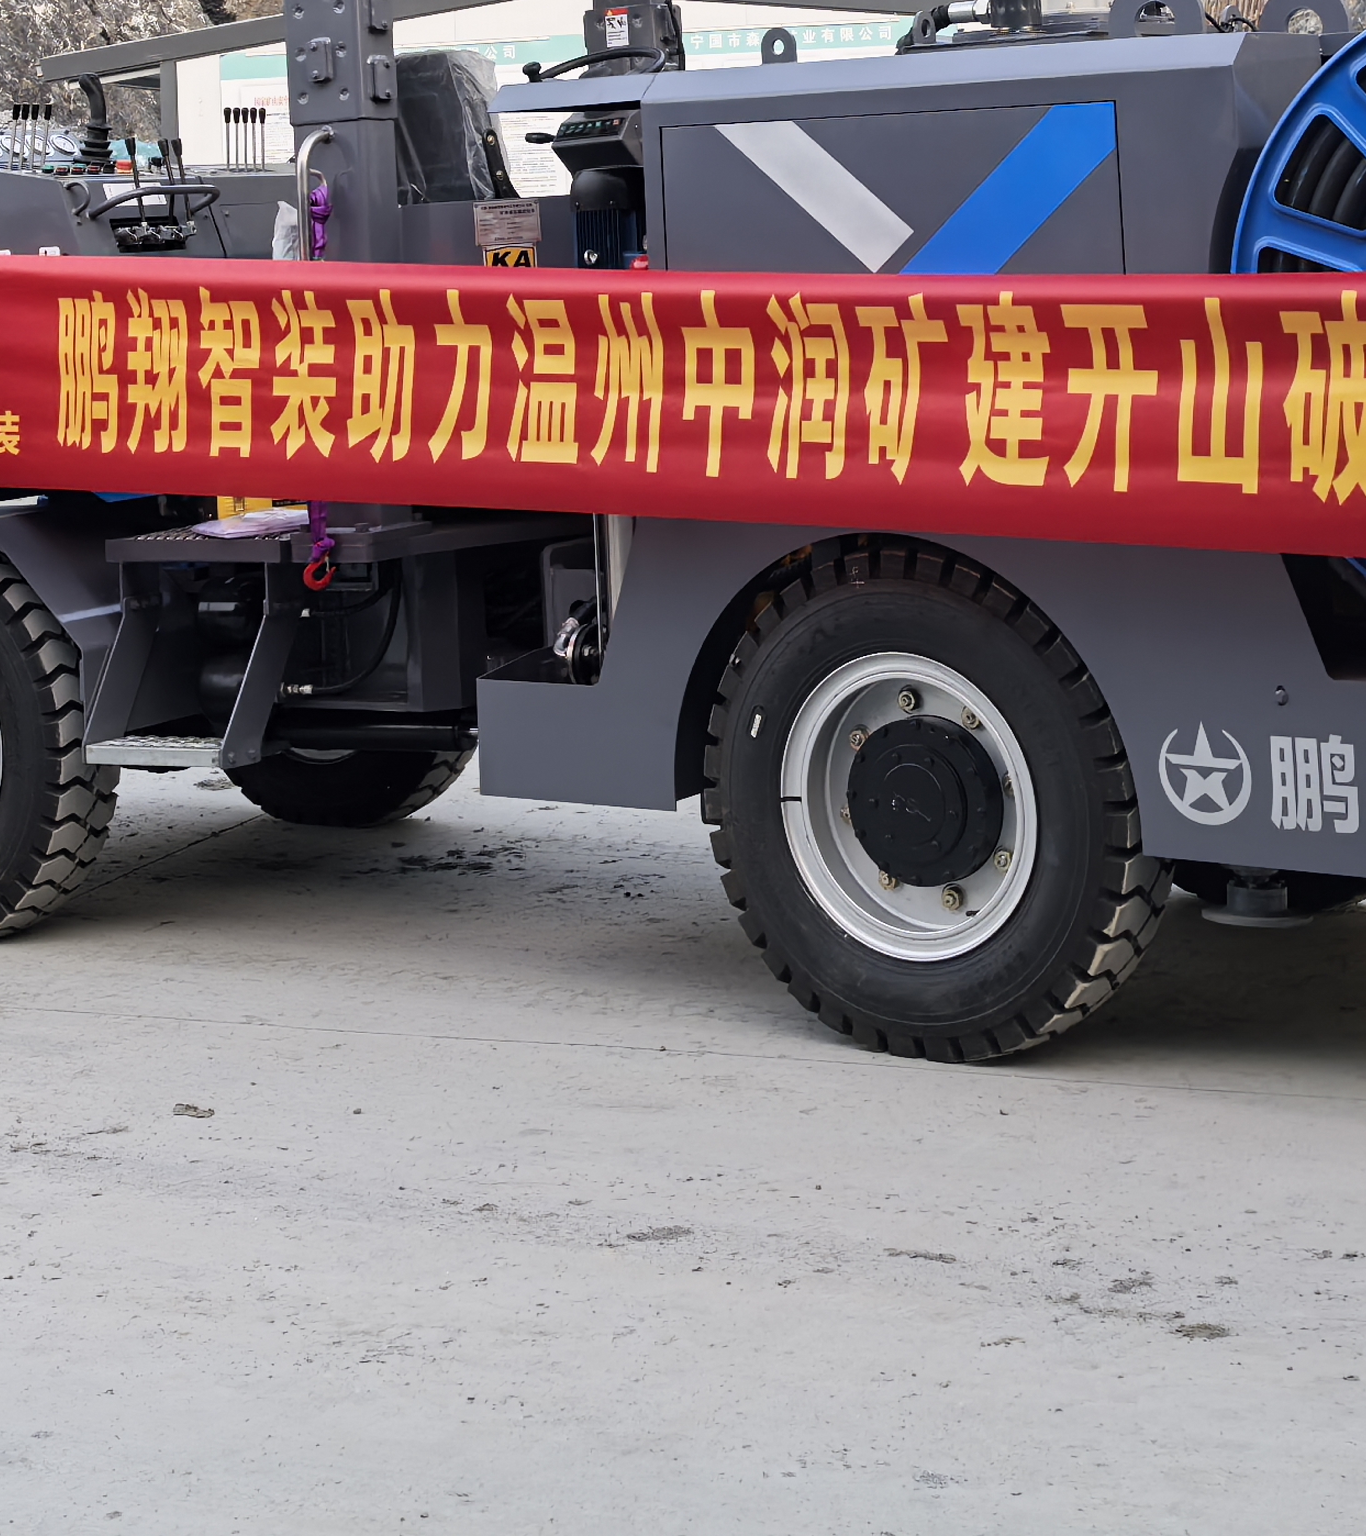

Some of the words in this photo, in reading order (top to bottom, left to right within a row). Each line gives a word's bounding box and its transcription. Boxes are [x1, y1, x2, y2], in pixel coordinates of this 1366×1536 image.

[690, 25, 893, 50] 宁国市森业有限公司
